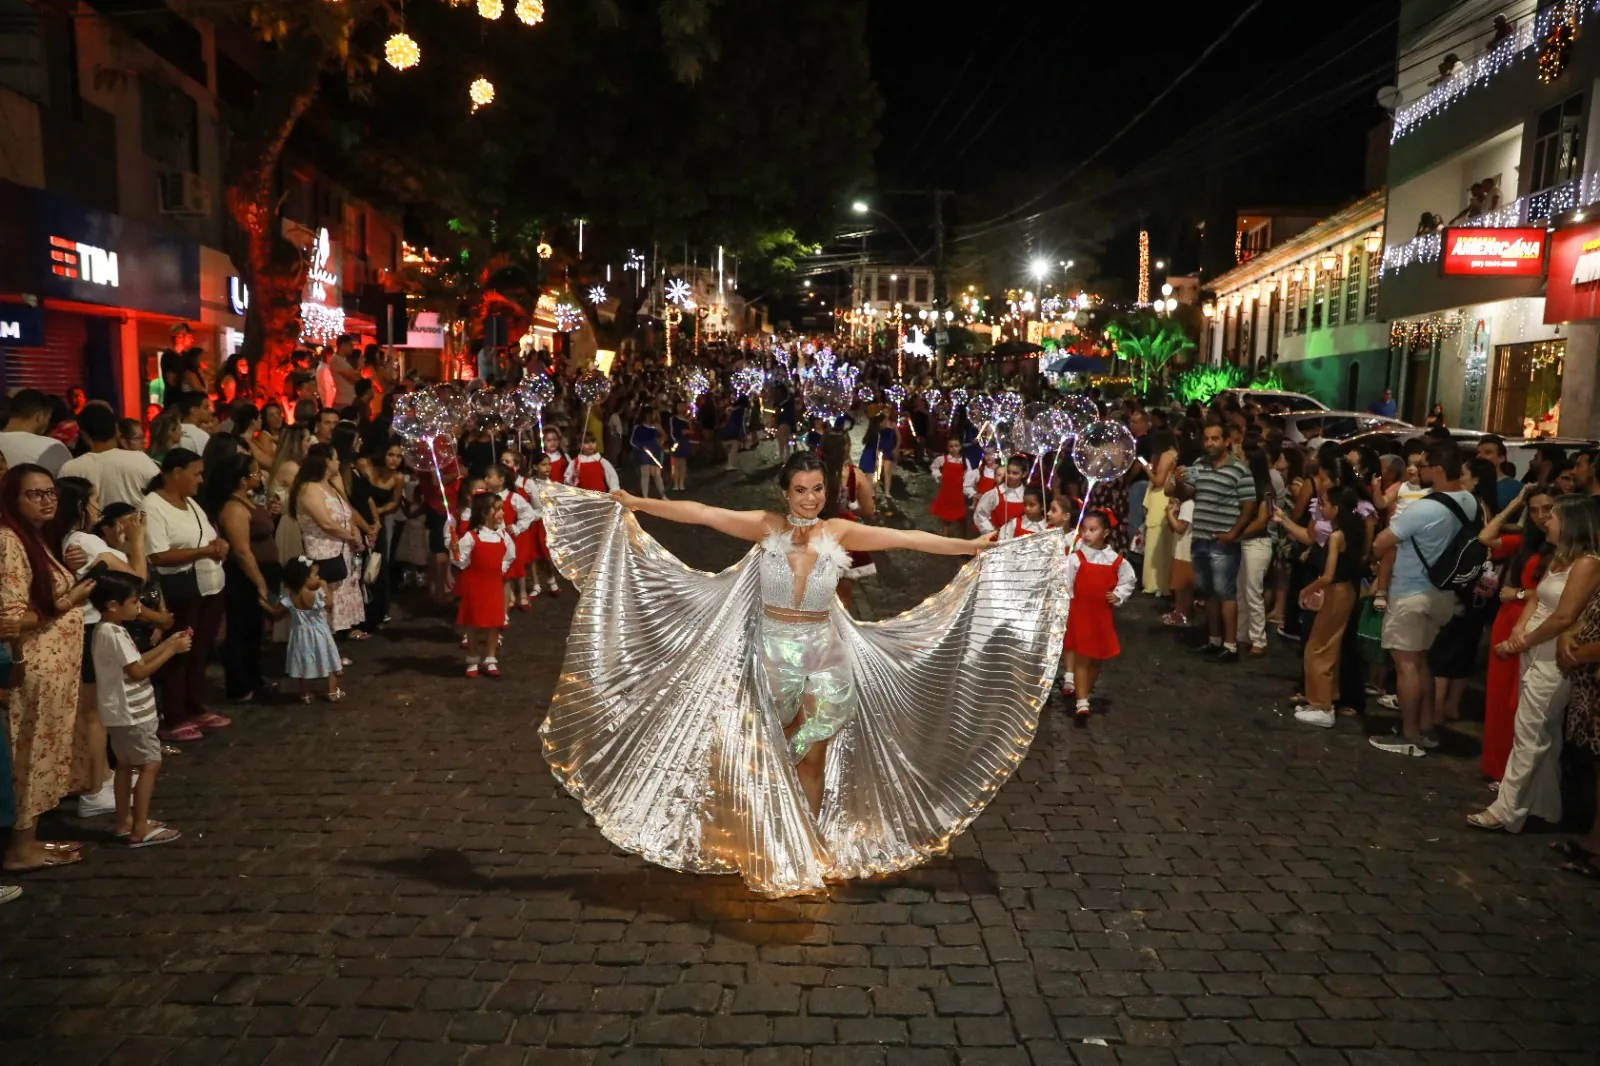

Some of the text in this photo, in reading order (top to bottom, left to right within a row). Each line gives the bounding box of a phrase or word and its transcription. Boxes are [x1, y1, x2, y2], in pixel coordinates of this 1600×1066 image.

[1451, 237, 1540, 258] AMERICANA
[75, 241, 119, 287] TIM
[0, 320, 20, 338] M
